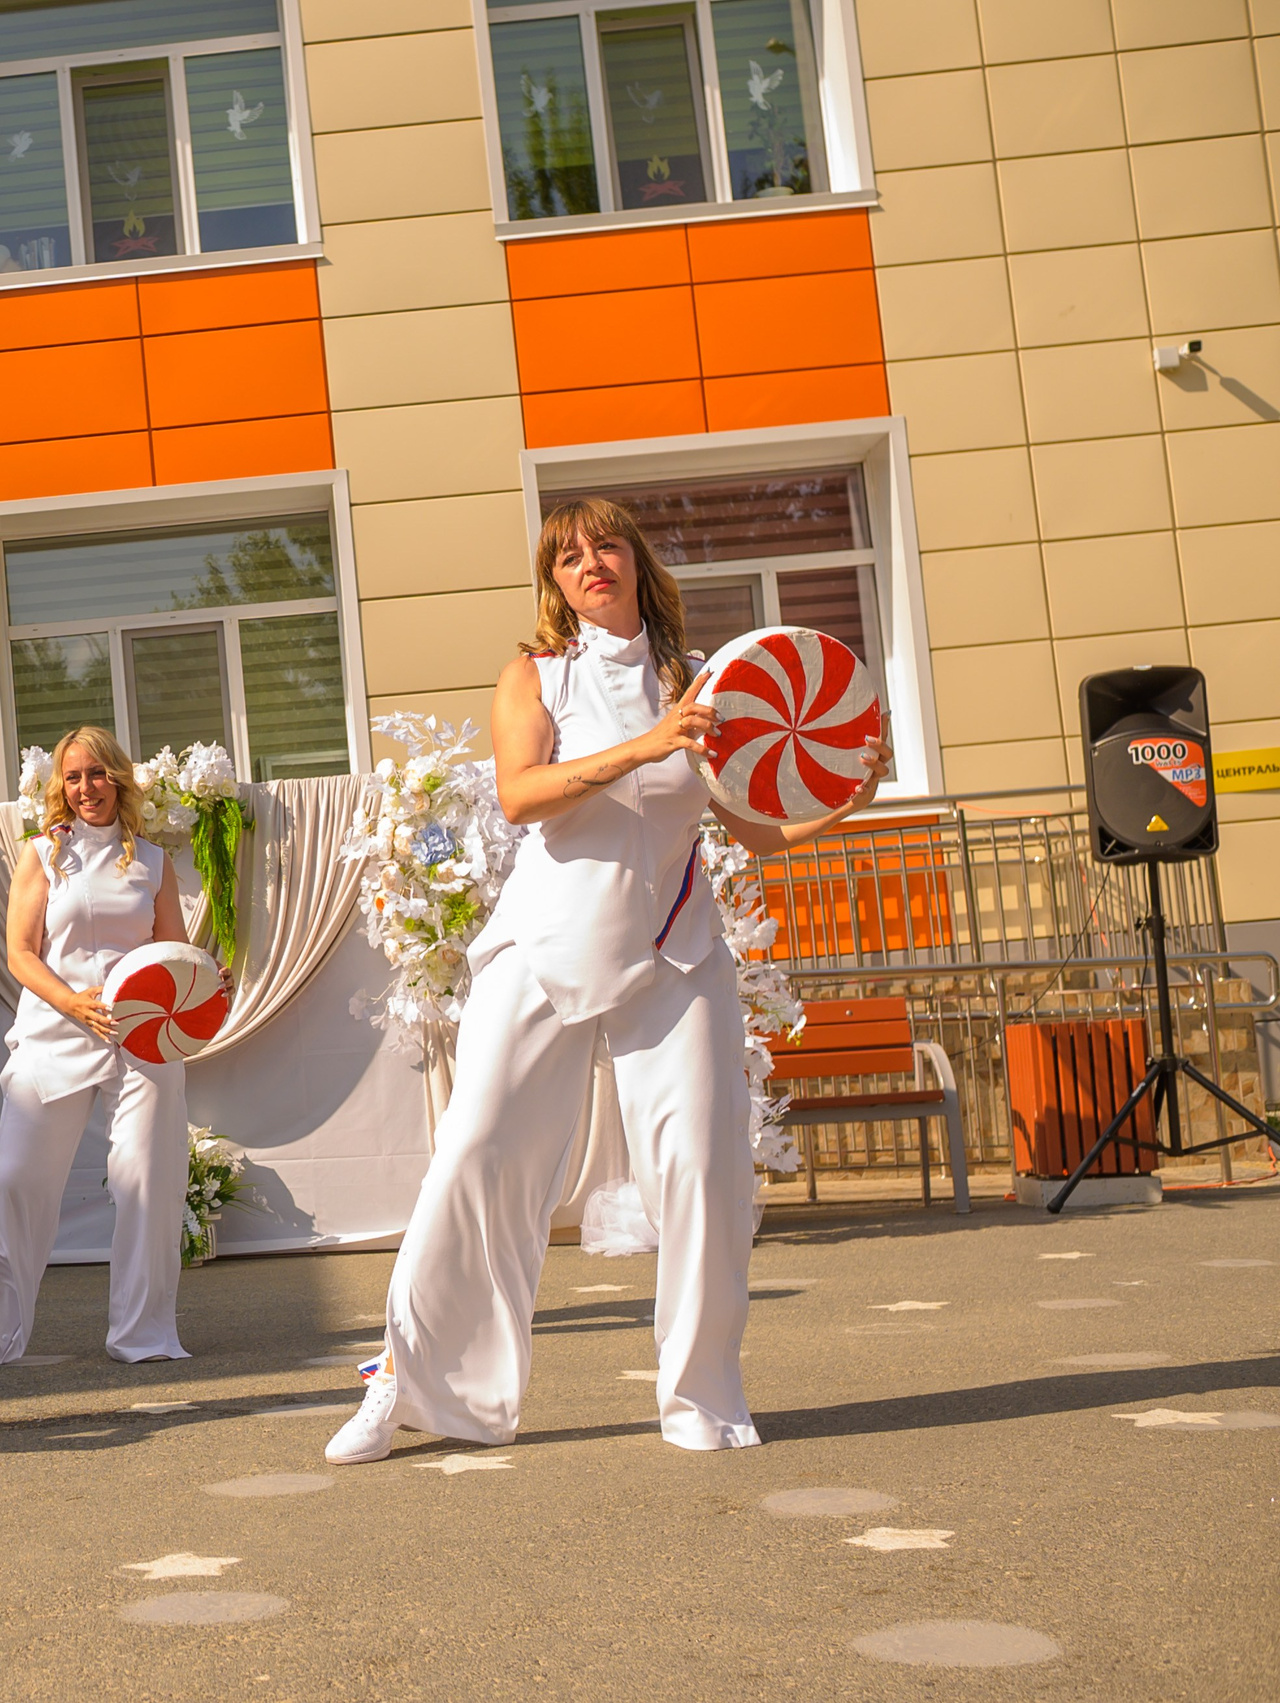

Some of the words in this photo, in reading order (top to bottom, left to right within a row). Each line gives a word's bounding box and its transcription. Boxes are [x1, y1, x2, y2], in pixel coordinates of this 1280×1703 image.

[1129, 742, 1187, 763] 1000
[1172, 768, 1201, 780] MP3
[1216, 763, 1280, 778] ЦЕНТРАЛЬ
